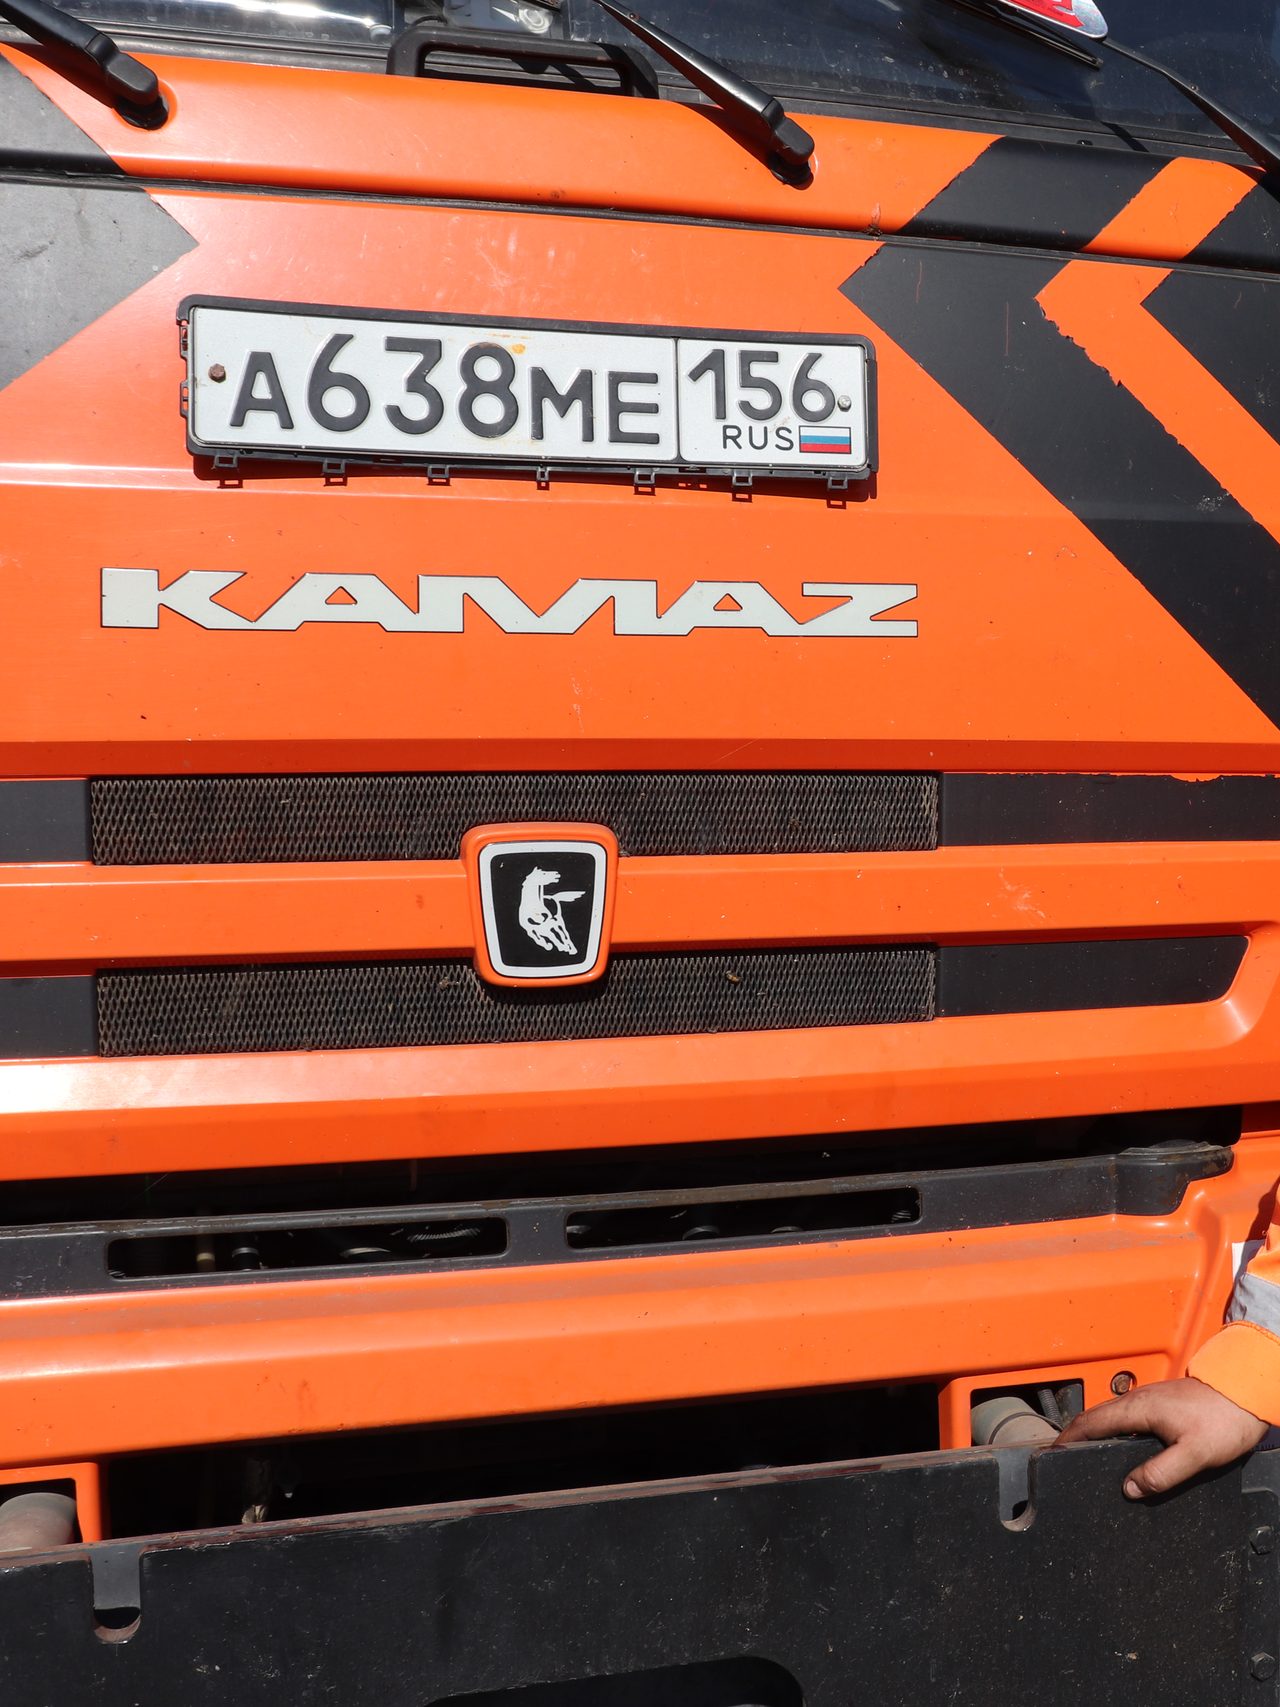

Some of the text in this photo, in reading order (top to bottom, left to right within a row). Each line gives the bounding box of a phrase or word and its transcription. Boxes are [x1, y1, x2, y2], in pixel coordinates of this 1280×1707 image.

[229, 333, 836, 444] А638МЕ 156
[722, 424, 794, 451] RUS
[100, 566, 919, 638] KAMAZ
